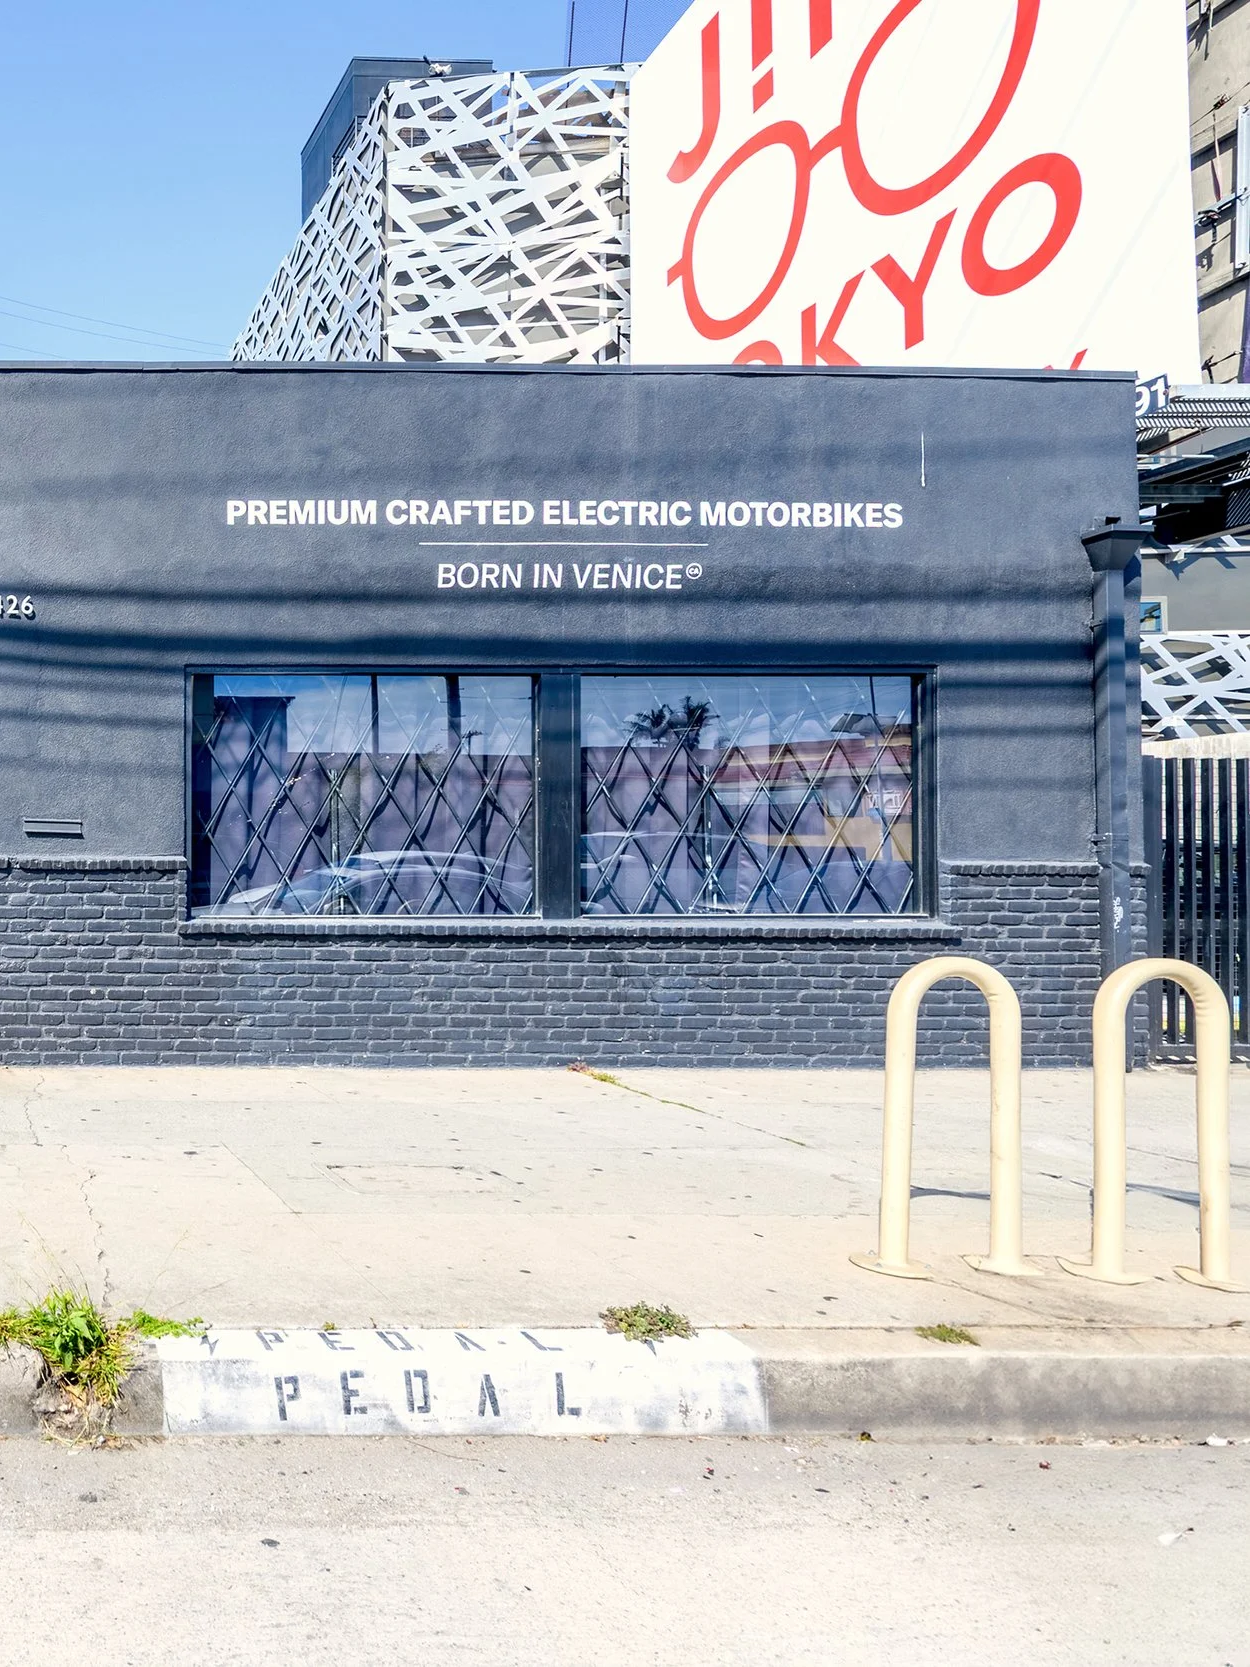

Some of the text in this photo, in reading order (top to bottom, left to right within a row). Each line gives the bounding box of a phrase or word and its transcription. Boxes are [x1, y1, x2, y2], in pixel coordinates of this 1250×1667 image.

[226, 499, 904, 529] PREMIUM CRAFTED ELECTRIC MOTORBIKES
[437, 562, 523, 589] BORN
[532, 563, 563, 589] IN
[572, 563, 684, 590] VENICE
[255, 1330, 564, 1352] PEDAL
[273, 1368, 583, 1422] PEDAL
